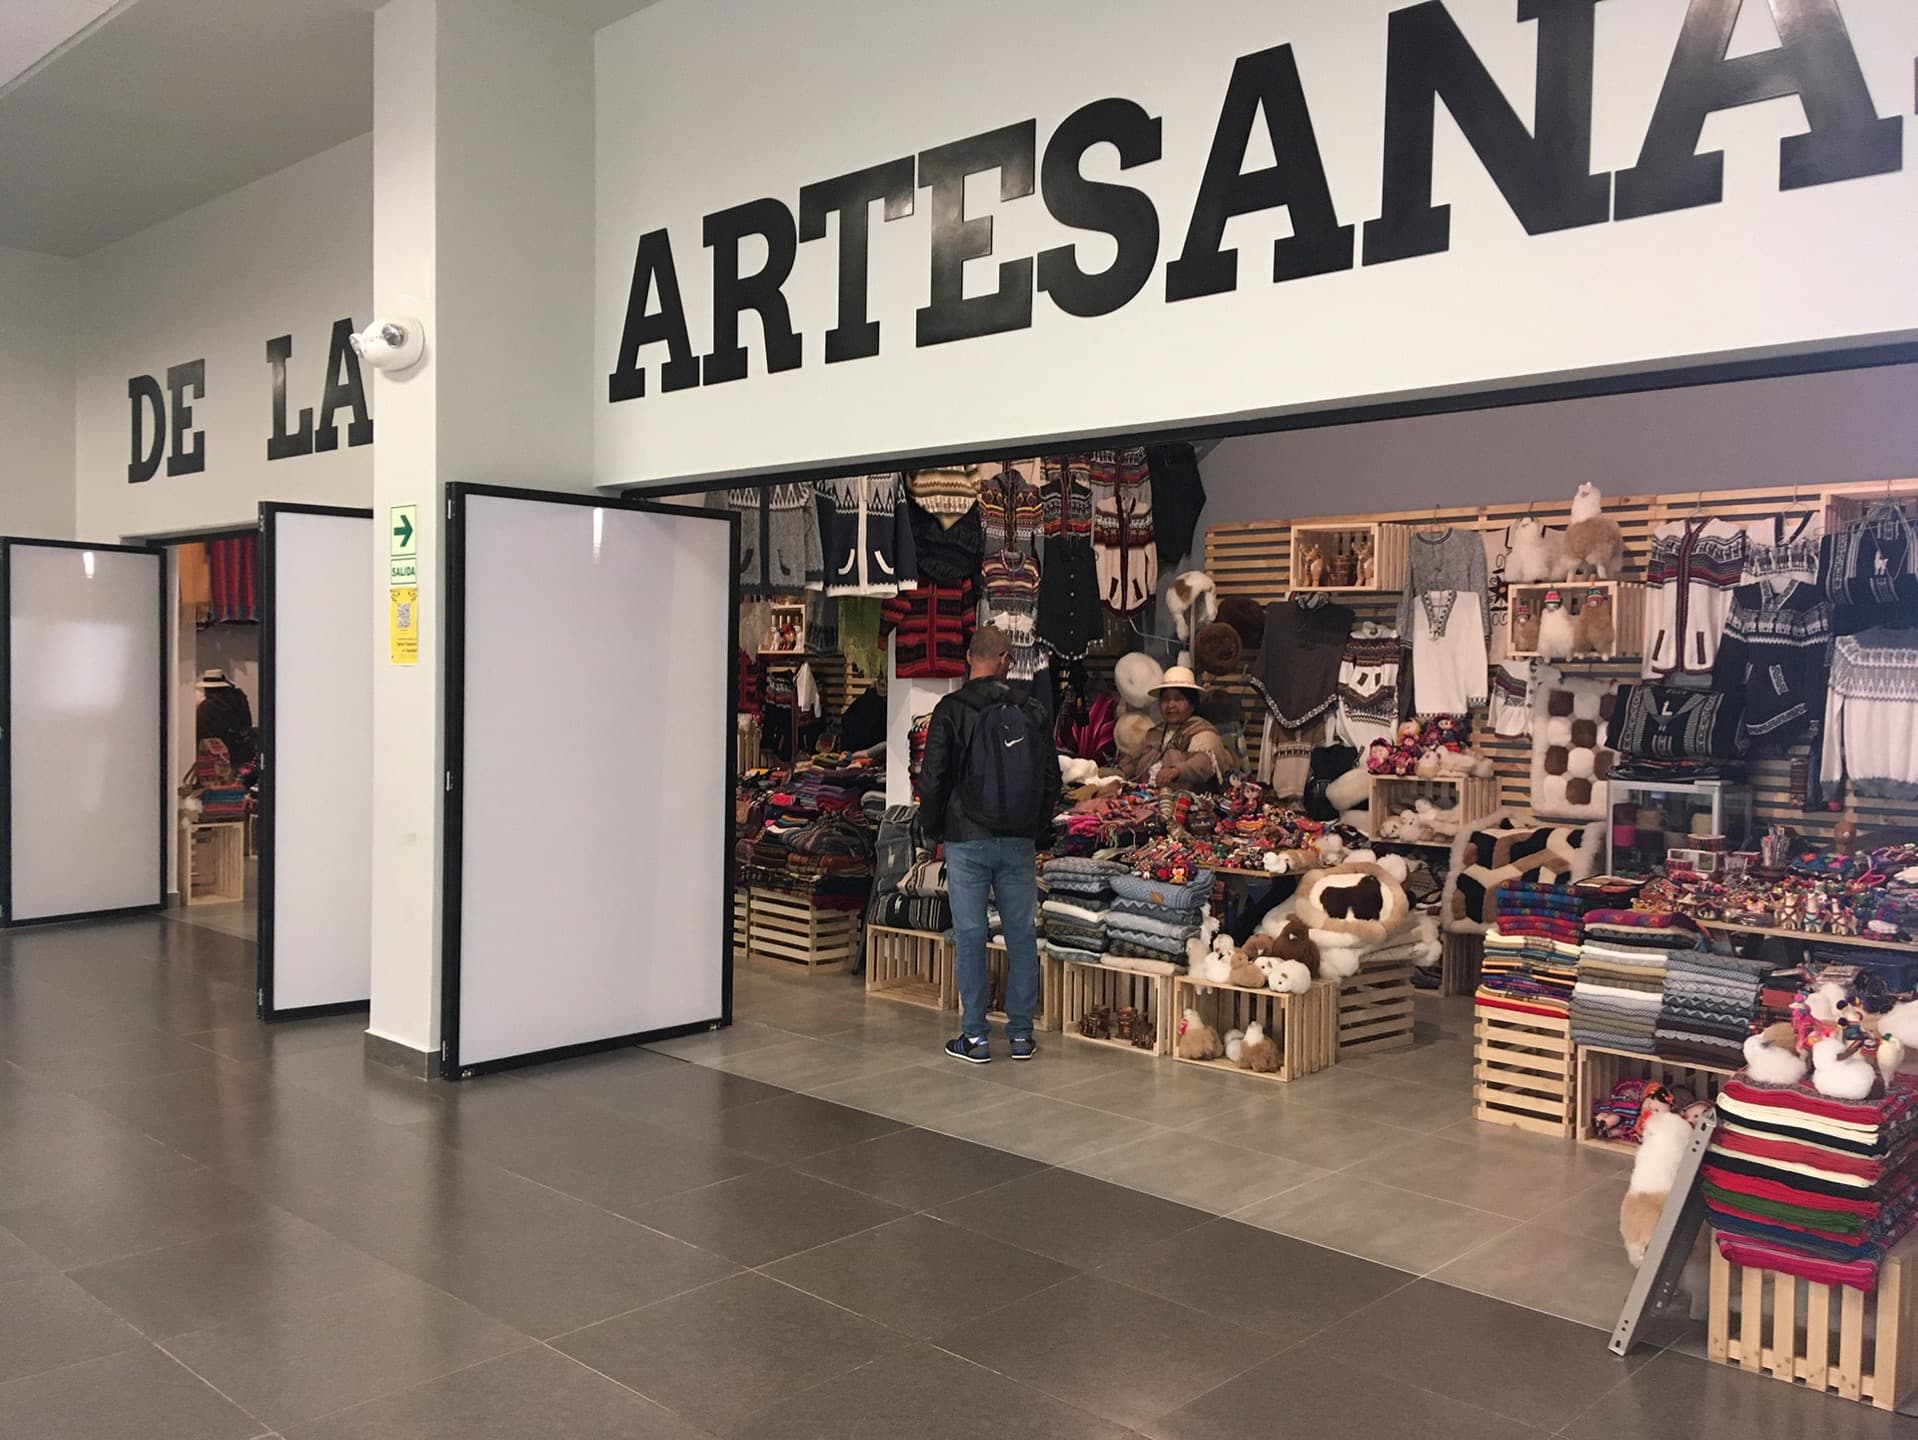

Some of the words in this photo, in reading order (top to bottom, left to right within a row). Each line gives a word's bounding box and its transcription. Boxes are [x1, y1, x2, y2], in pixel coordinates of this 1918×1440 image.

[609, 0, 1918, 402] ARTESANA
[128, 358, 205, 484] DE
[266, 317, 374, 461] LA
[391, 566, 416, 577] SALIDA
